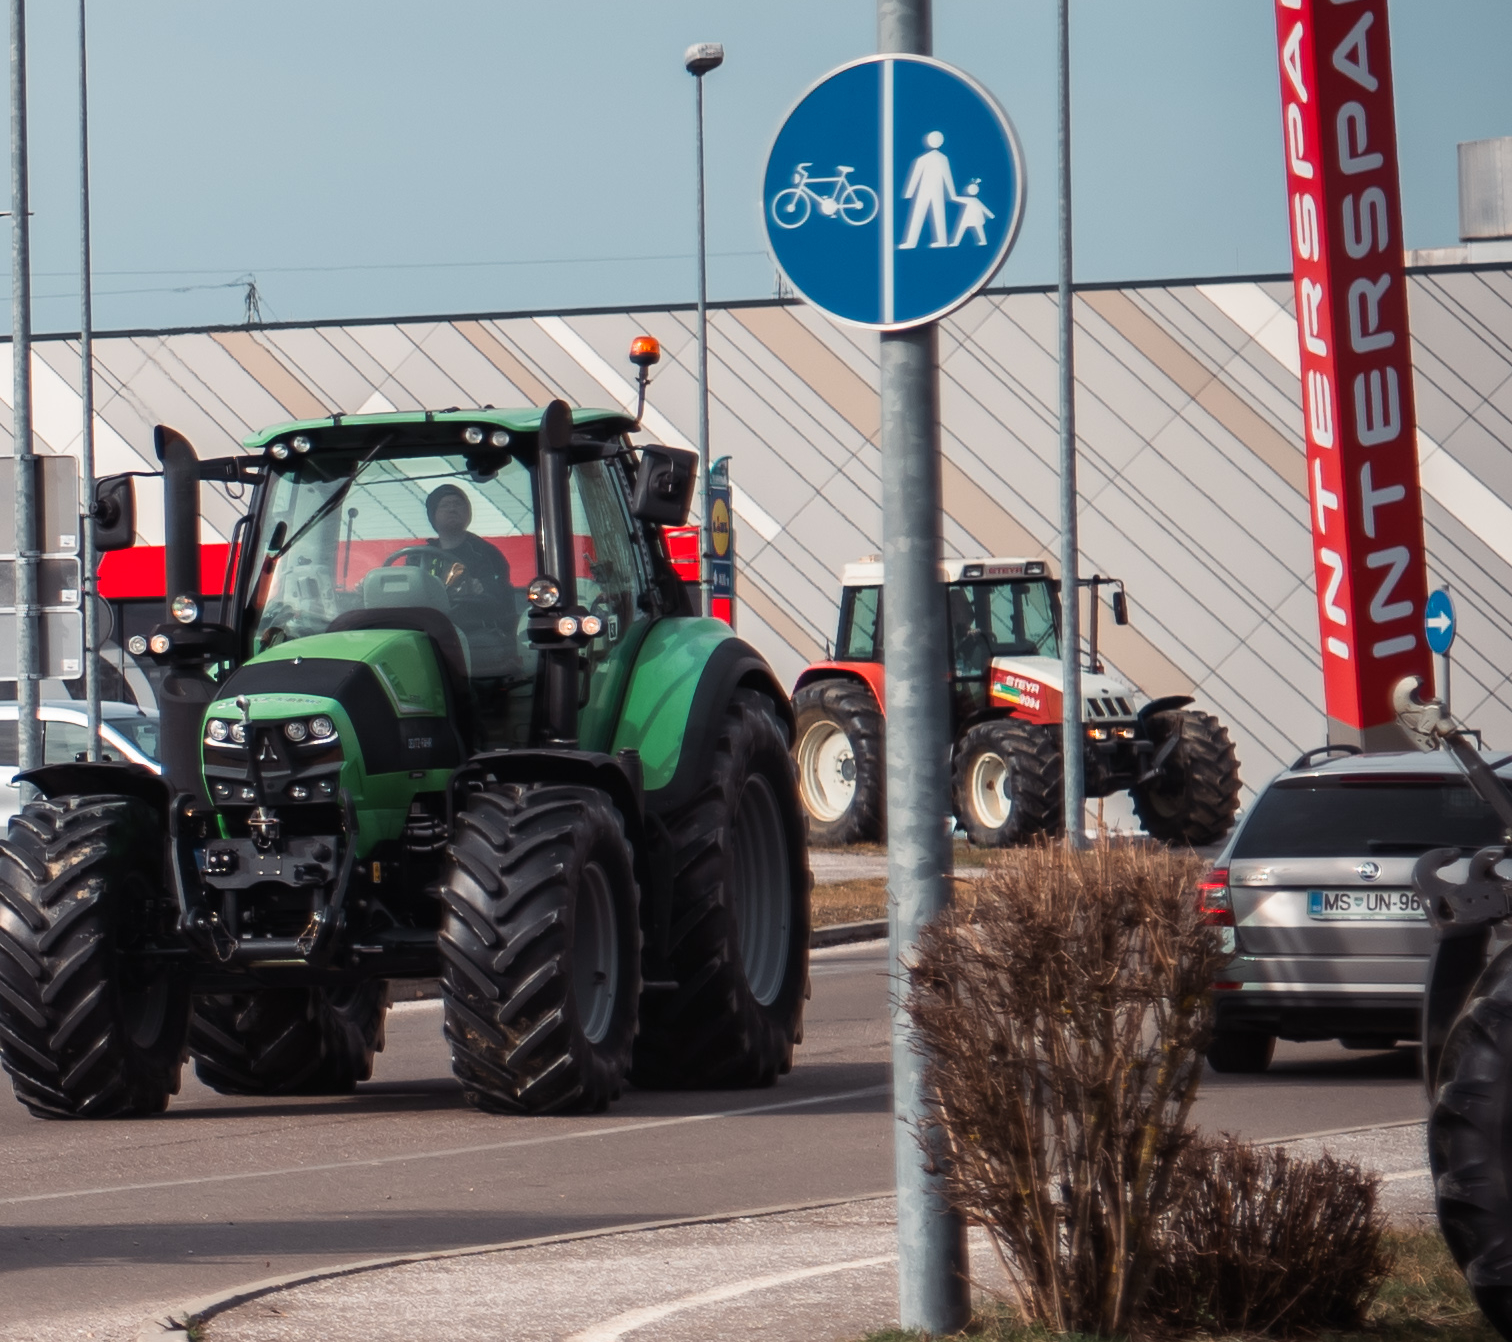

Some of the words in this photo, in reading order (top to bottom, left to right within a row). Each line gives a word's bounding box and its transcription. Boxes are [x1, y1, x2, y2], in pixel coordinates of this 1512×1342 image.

[988, 567, 1023, 575] STEYR
[1005, 675, 1040, 694] STEYR
[1324, 893, 1351, 910] MS
[1366, 892, 1421, 911] UN-96
